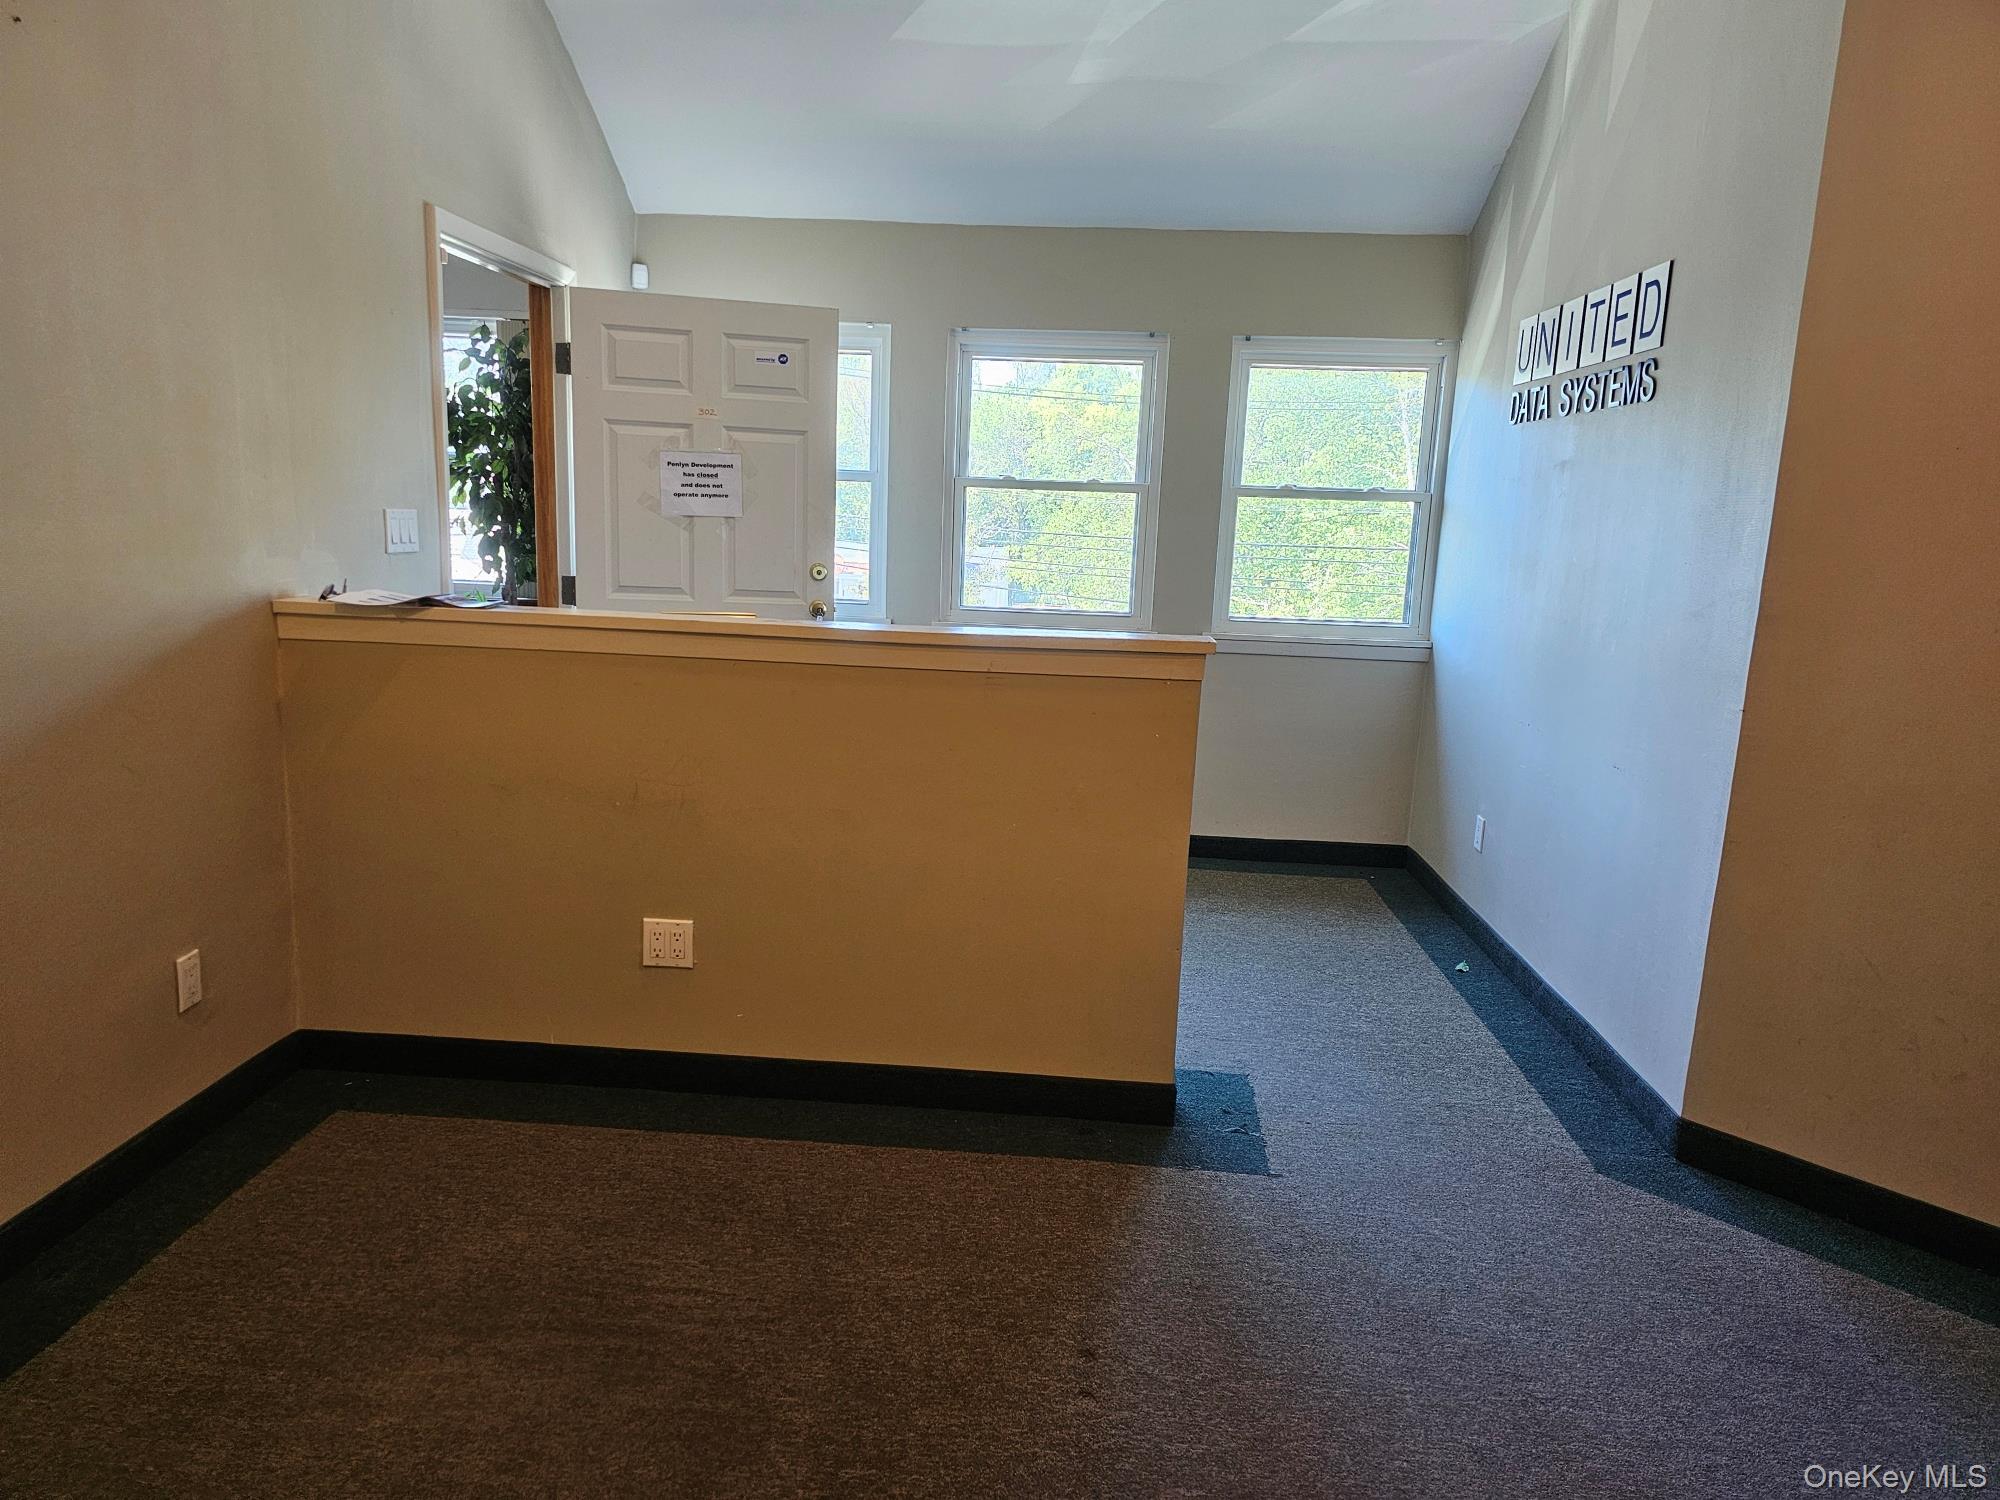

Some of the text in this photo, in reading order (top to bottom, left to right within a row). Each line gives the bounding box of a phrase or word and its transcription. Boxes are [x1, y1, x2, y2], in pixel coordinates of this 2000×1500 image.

[1518, 279, 1662, 372] UNITED
[1508, 357, 1659, 425] DATA SYSTEMS
